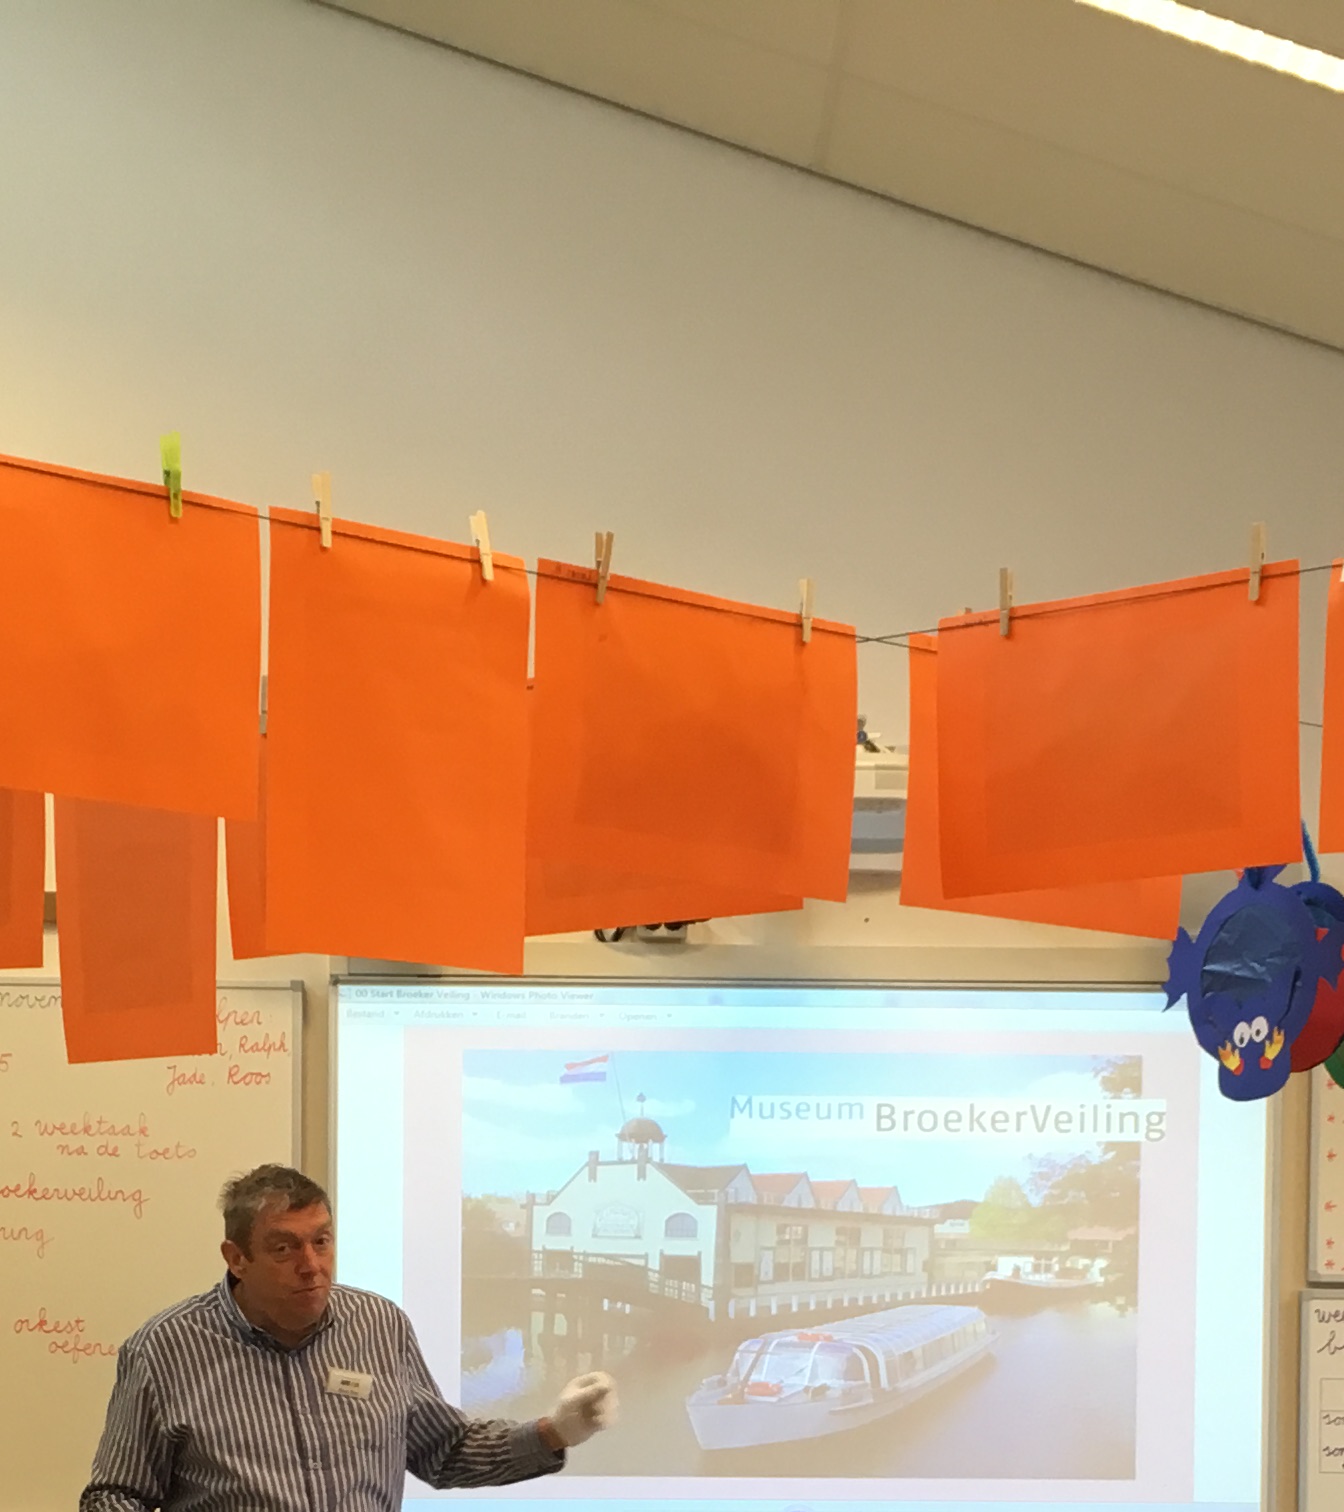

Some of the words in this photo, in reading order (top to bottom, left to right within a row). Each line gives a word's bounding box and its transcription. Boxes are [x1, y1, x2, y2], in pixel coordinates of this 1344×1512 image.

[370, 988, 394, 998] Start
[479, 990, 526, 1000] Windows
[528, 991, 559, 1000] Photo
[560, 991, 594, 1000] Viewer
[413, 1009, 464, 1019] Afdrukken
[227, 1064, 272, 1087] Roos
[10, 1120, 23, 1138] 2
[34, 1111, 150, 1138] weektaak
[729, 1096, 865, 1121] Museum
[875, 1102, 1168, 1142] BroekerVeiling
[56, 1142, 88, 1157] na
[96, 1141, 121, 1158] de
[134, 1139, 198, 1161] toets
[13, 1306, 86, 1335] orkest
[47, 1333, 118, 1365] oefene
